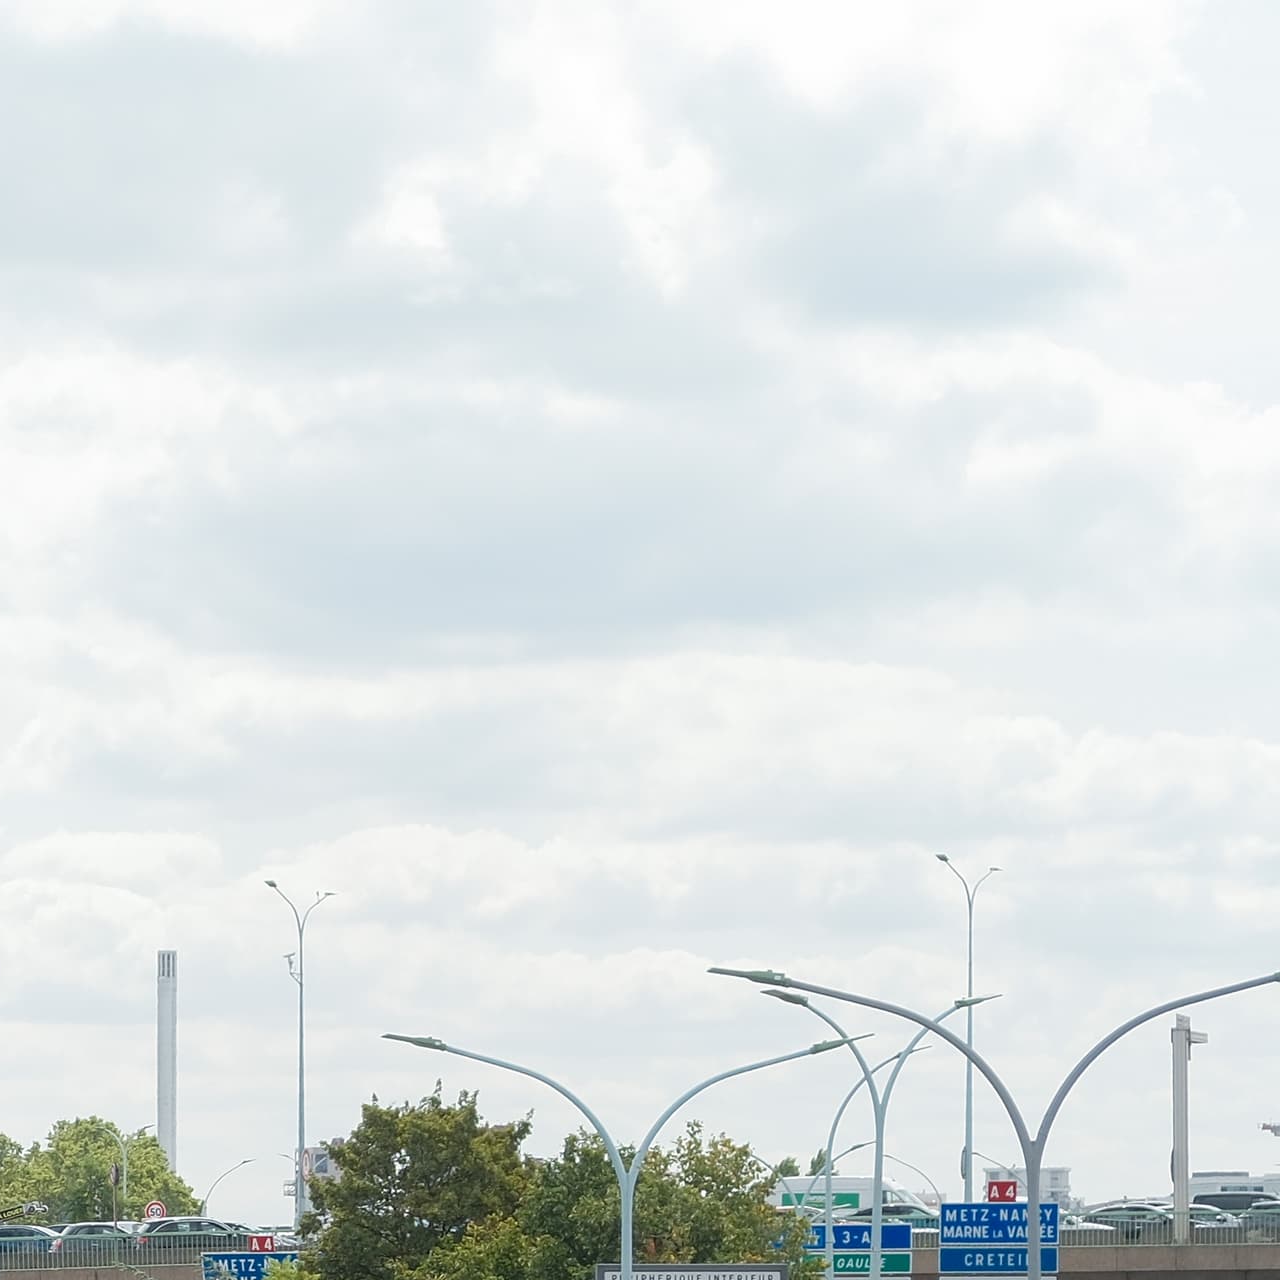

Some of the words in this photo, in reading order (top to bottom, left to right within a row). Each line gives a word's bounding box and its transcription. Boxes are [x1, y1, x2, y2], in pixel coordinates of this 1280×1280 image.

[149, 1206, 162, 1217] 50
[945, 1208, 1053, 1222] METZ-NANY
[943, 1225, 990, 1238] MARNE
[992, 1229, 1004, 1238] LA
[1007, 1223, 1055, 1238] VAÉE
[836, 1257, 887, 1269] GAULE
